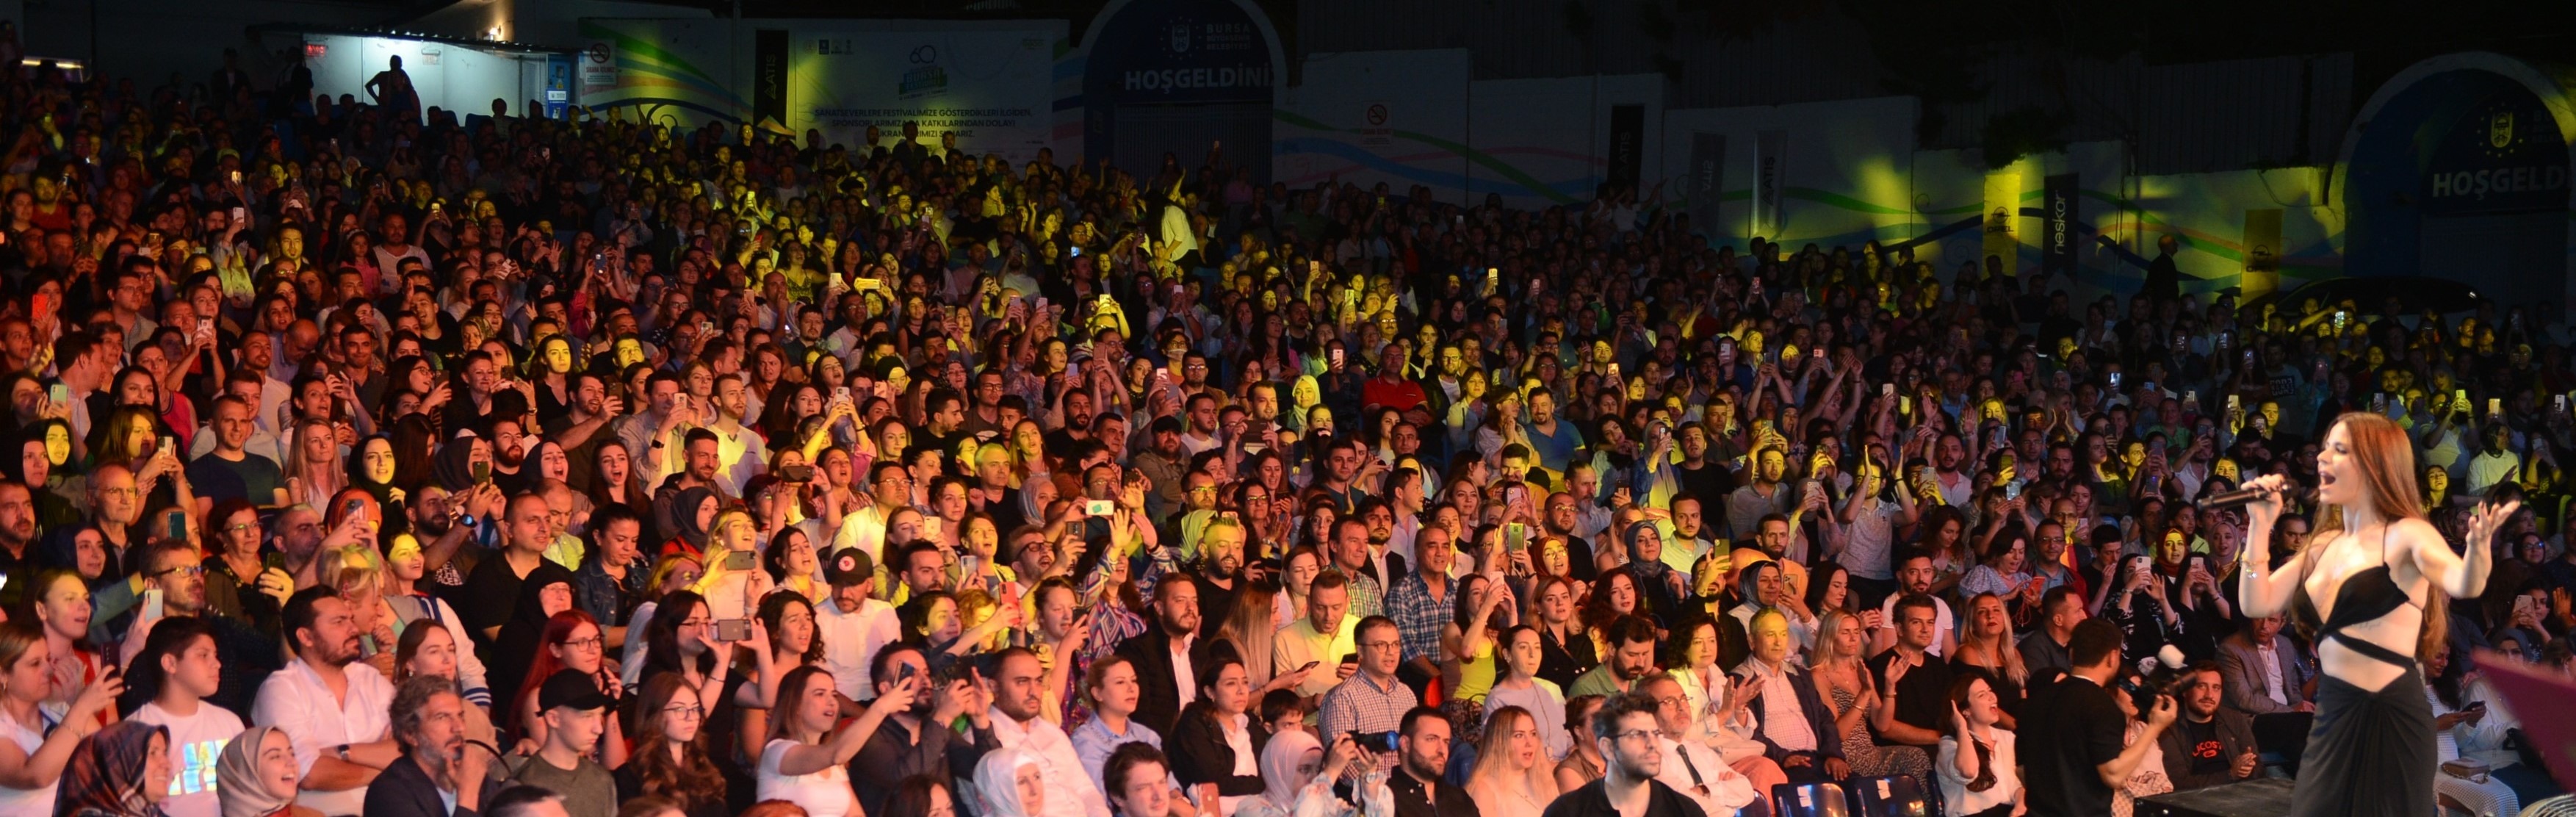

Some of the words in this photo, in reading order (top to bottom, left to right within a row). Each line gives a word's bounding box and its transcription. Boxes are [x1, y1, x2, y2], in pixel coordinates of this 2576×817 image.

[1206, 23, 1251, 34] BURSA
[1125, 62, 1274, 95] HOŞGELDİNİ
[883, 107, 937, 117] FESTİVALİMİZE
[1987, 225, 2015, 233] OPEL
[2245, 264, 2276, 273] OPEL
